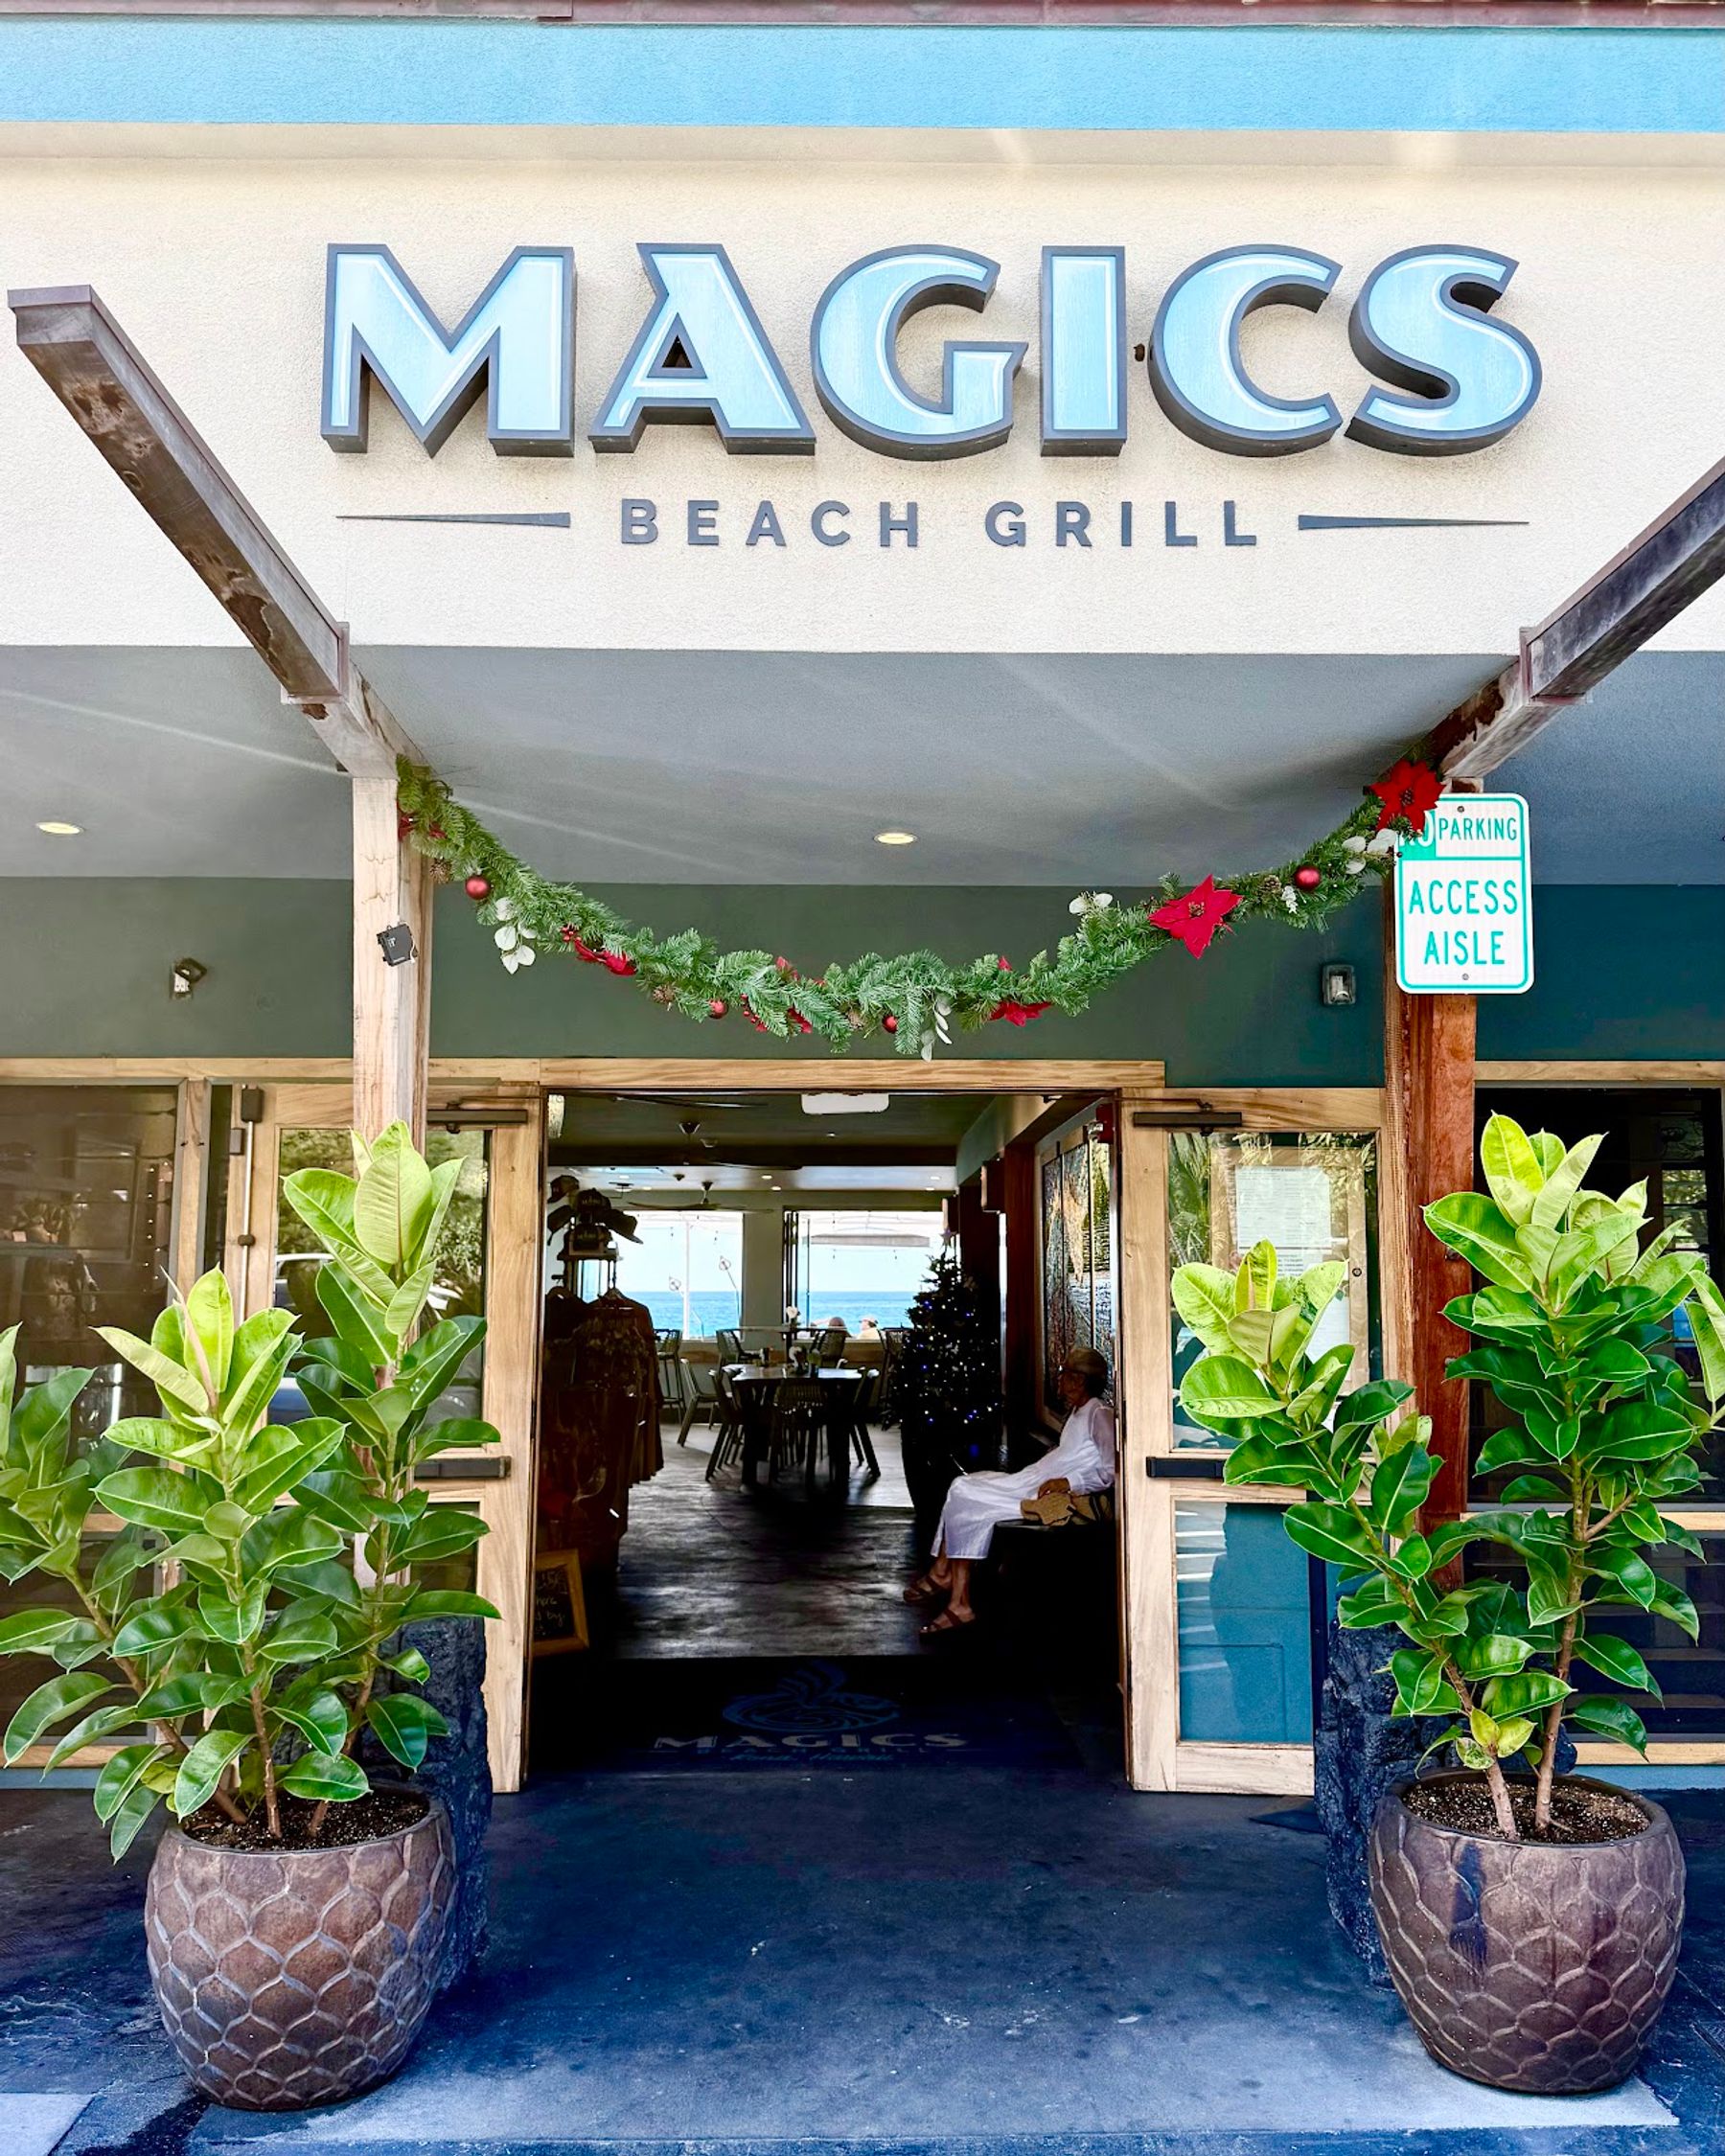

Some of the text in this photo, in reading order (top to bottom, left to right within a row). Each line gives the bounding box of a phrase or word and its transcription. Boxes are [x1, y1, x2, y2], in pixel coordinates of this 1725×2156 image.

[321, 243, 1542, 459] MAGICS
[621, 498, 1256, 546] BEACH GRILL
[1439, 817, 1517, 840] PARKING
[1409, 880, 1517, 914] ACCESS
[1424, 930, 1505, 965] AISLE
[653, 1733, 968, 1749] MAGICS
